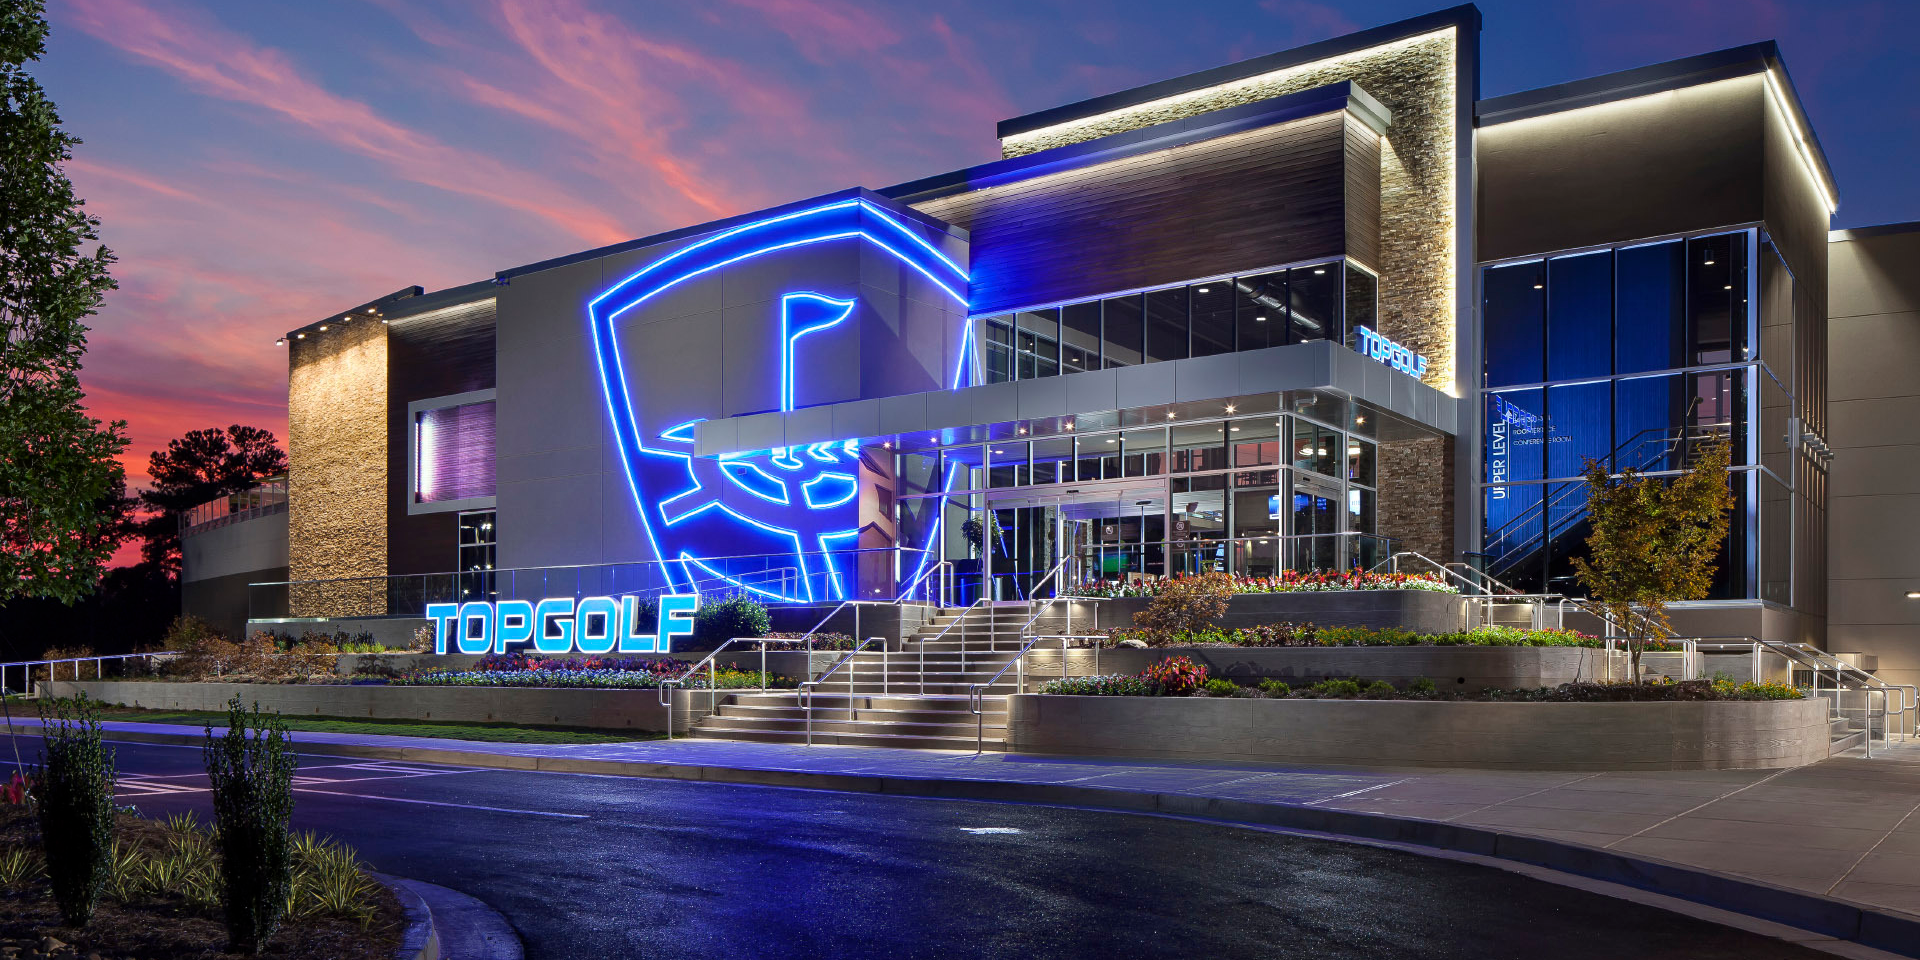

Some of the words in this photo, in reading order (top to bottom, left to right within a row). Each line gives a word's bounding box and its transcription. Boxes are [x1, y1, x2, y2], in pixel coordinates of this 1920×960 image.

[1358, 325, 1428, 380] TOPGOLF
[1493, 419, 1505, 456] LEVEL
[1513, 437, 1552, 445] CONFERENE
[1493, 460, 1505, 499] UPPER
[426, 594, 700, 655] TOPGOLF
